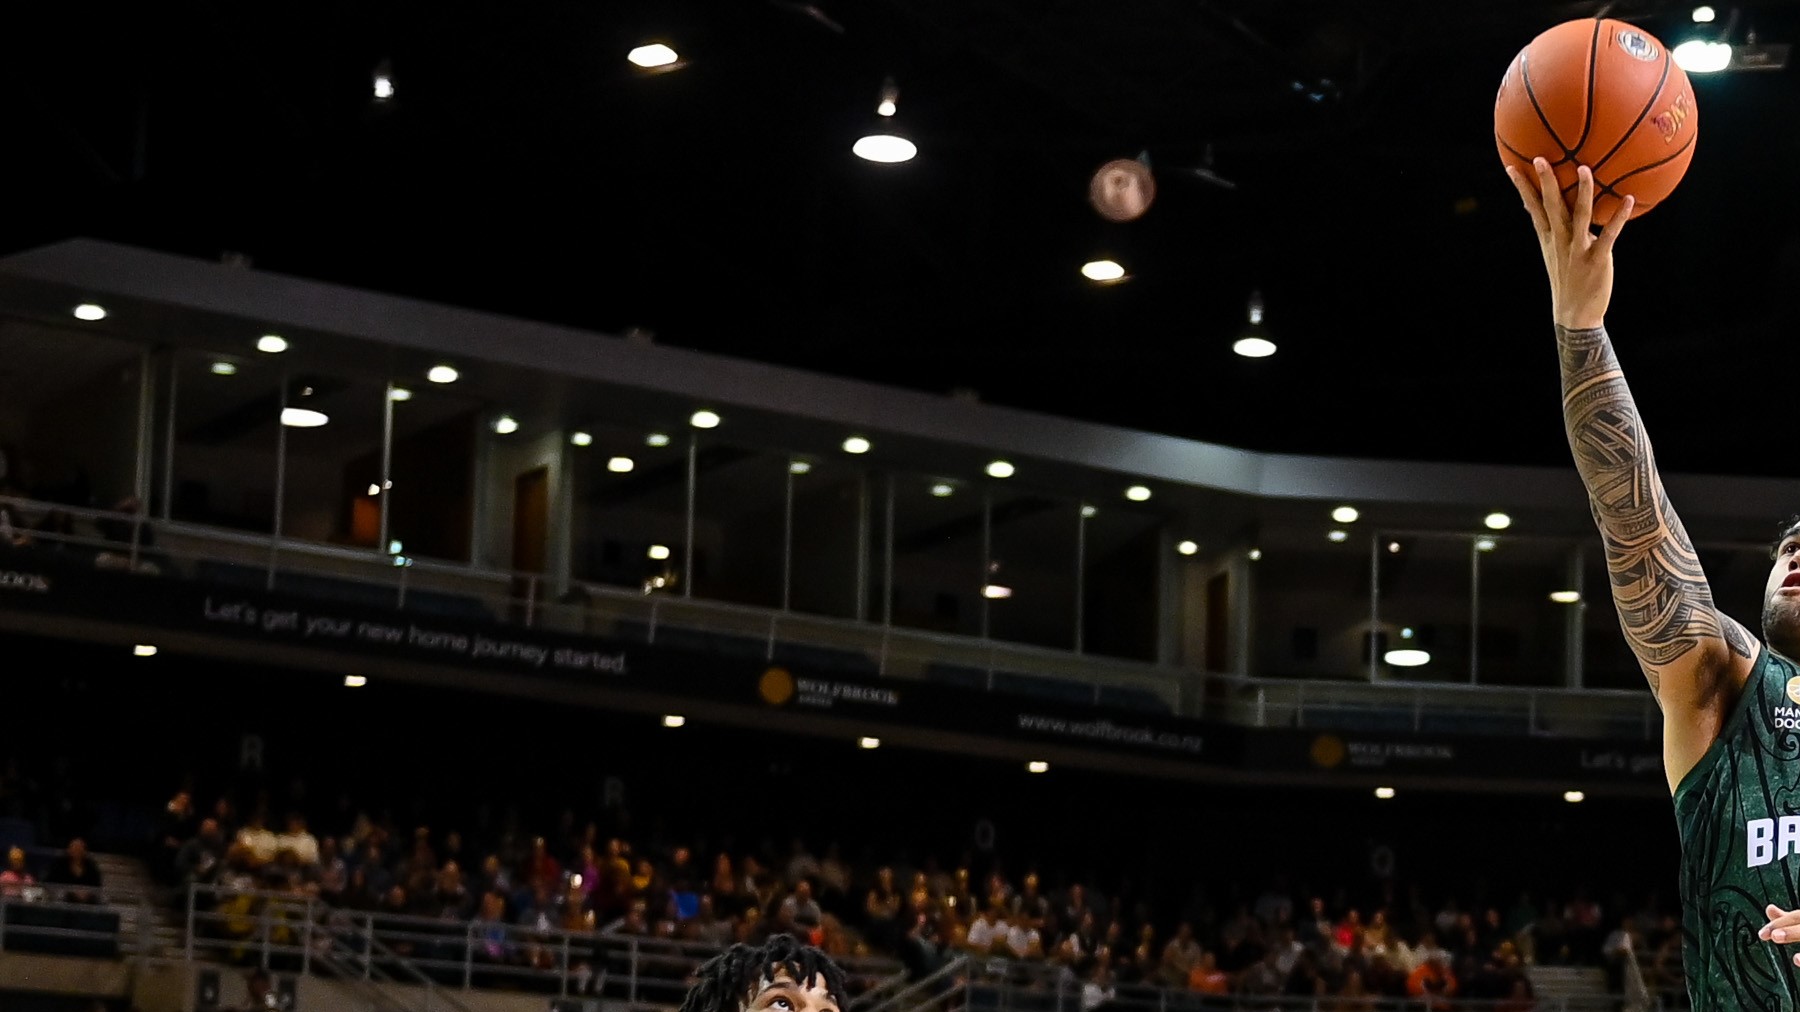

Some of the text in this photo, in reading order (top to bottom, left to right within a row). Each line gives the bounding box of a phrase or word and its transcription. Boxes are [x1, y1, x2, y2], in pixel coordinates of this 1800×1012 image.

[304, 615, 351, 637] your
[408, 624, 468, 652] home
[472, 637, 547, 667] journey
